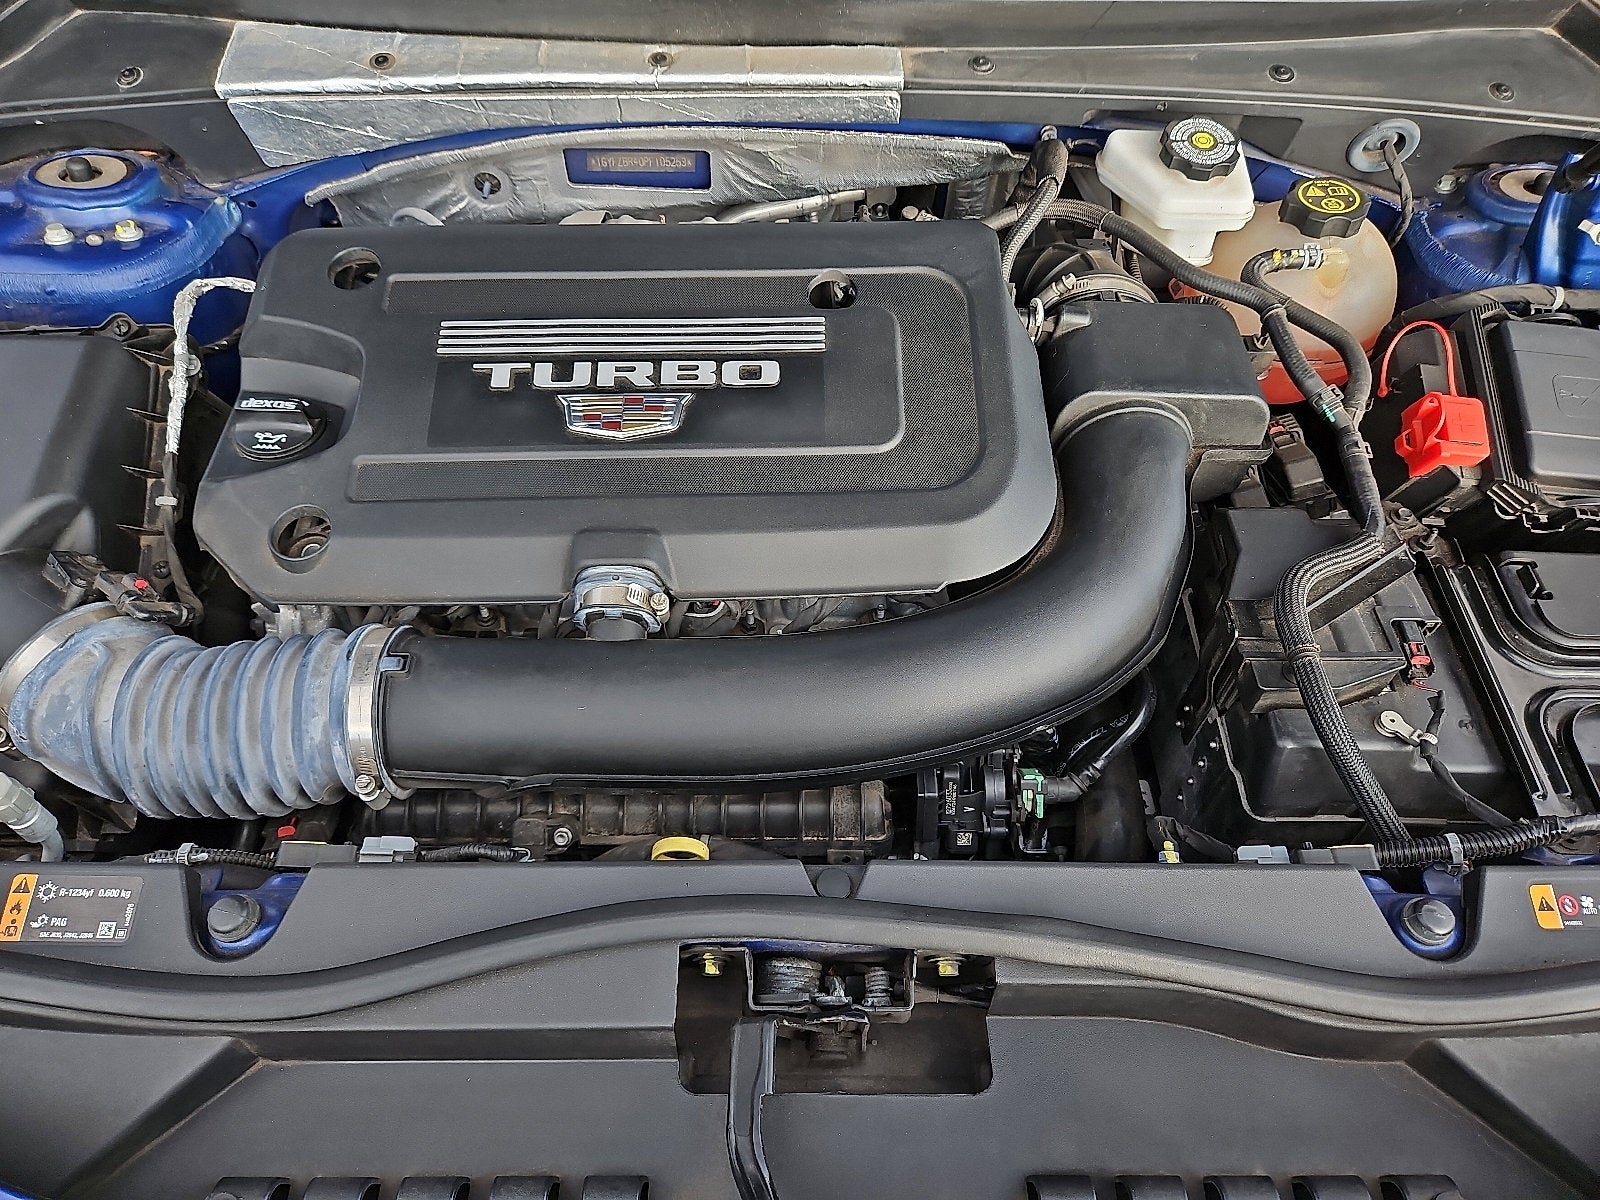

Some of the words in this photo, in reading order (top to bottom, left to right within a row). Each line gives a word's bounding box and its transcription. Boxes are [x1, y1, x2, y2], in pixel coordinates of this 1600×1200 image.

[472, 360, 781, 390] TURBO
[240, 397, 298, 410] dexos
[58, 888, 95, 899] R-1234yf
[98, 888, 120, 898] 0.600
[120, 888, 132, 899] kg
[50, 917, 68, 927] PAG
